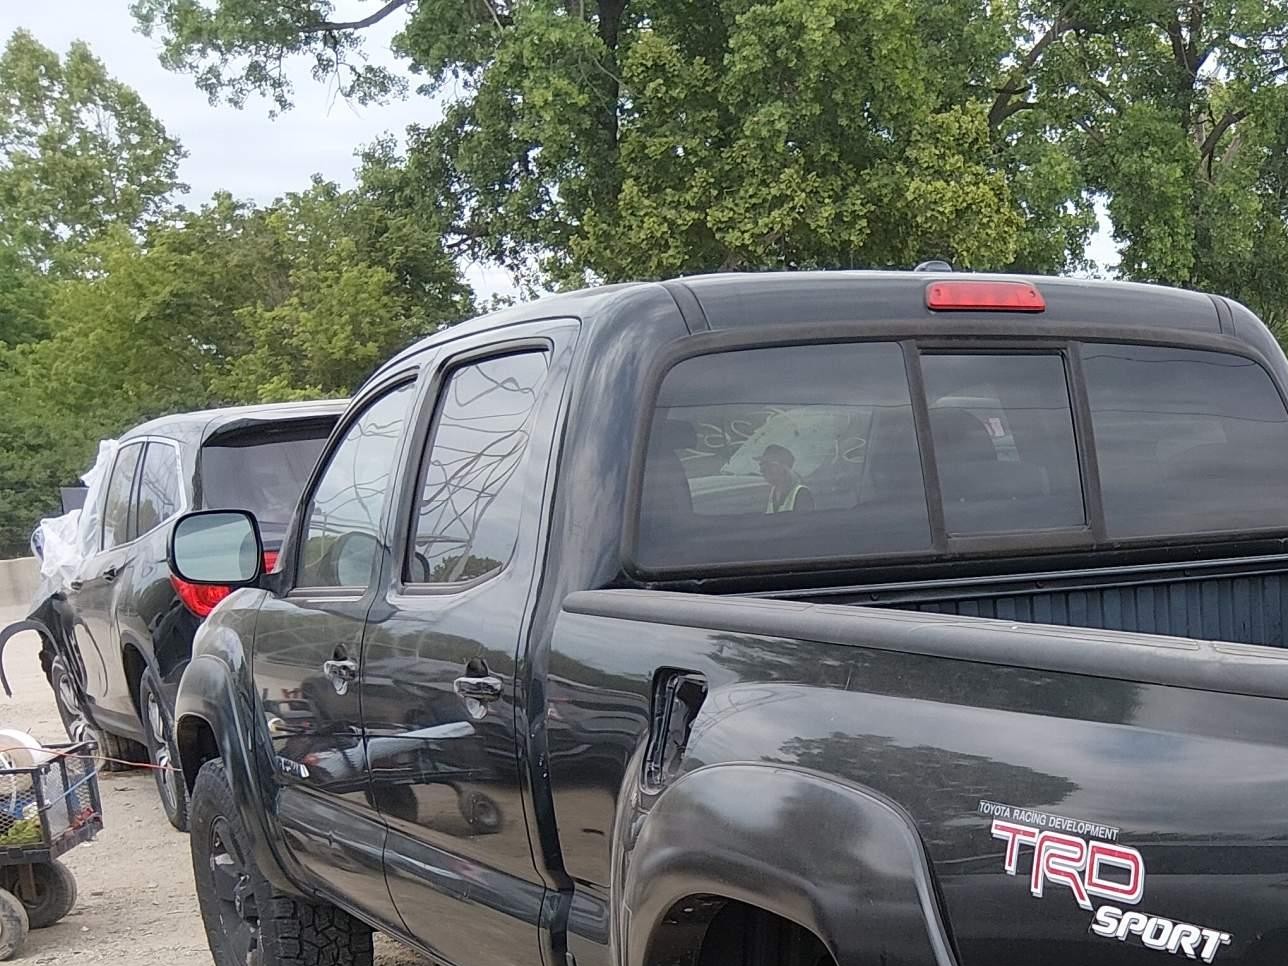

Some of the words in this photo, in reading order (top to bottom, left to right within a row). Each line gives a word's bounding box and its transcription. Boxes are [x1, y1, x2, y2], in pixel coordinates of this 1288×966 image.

[978, 801, 1011, 820] TOYOTA
[1012, 808, 1047, 826] RACING
[1049, 815, 1120, 841] DEVELOPMENT
[990, 818, 1145, 911] TRD
[1090, 905, 1233, 964] SPORT
